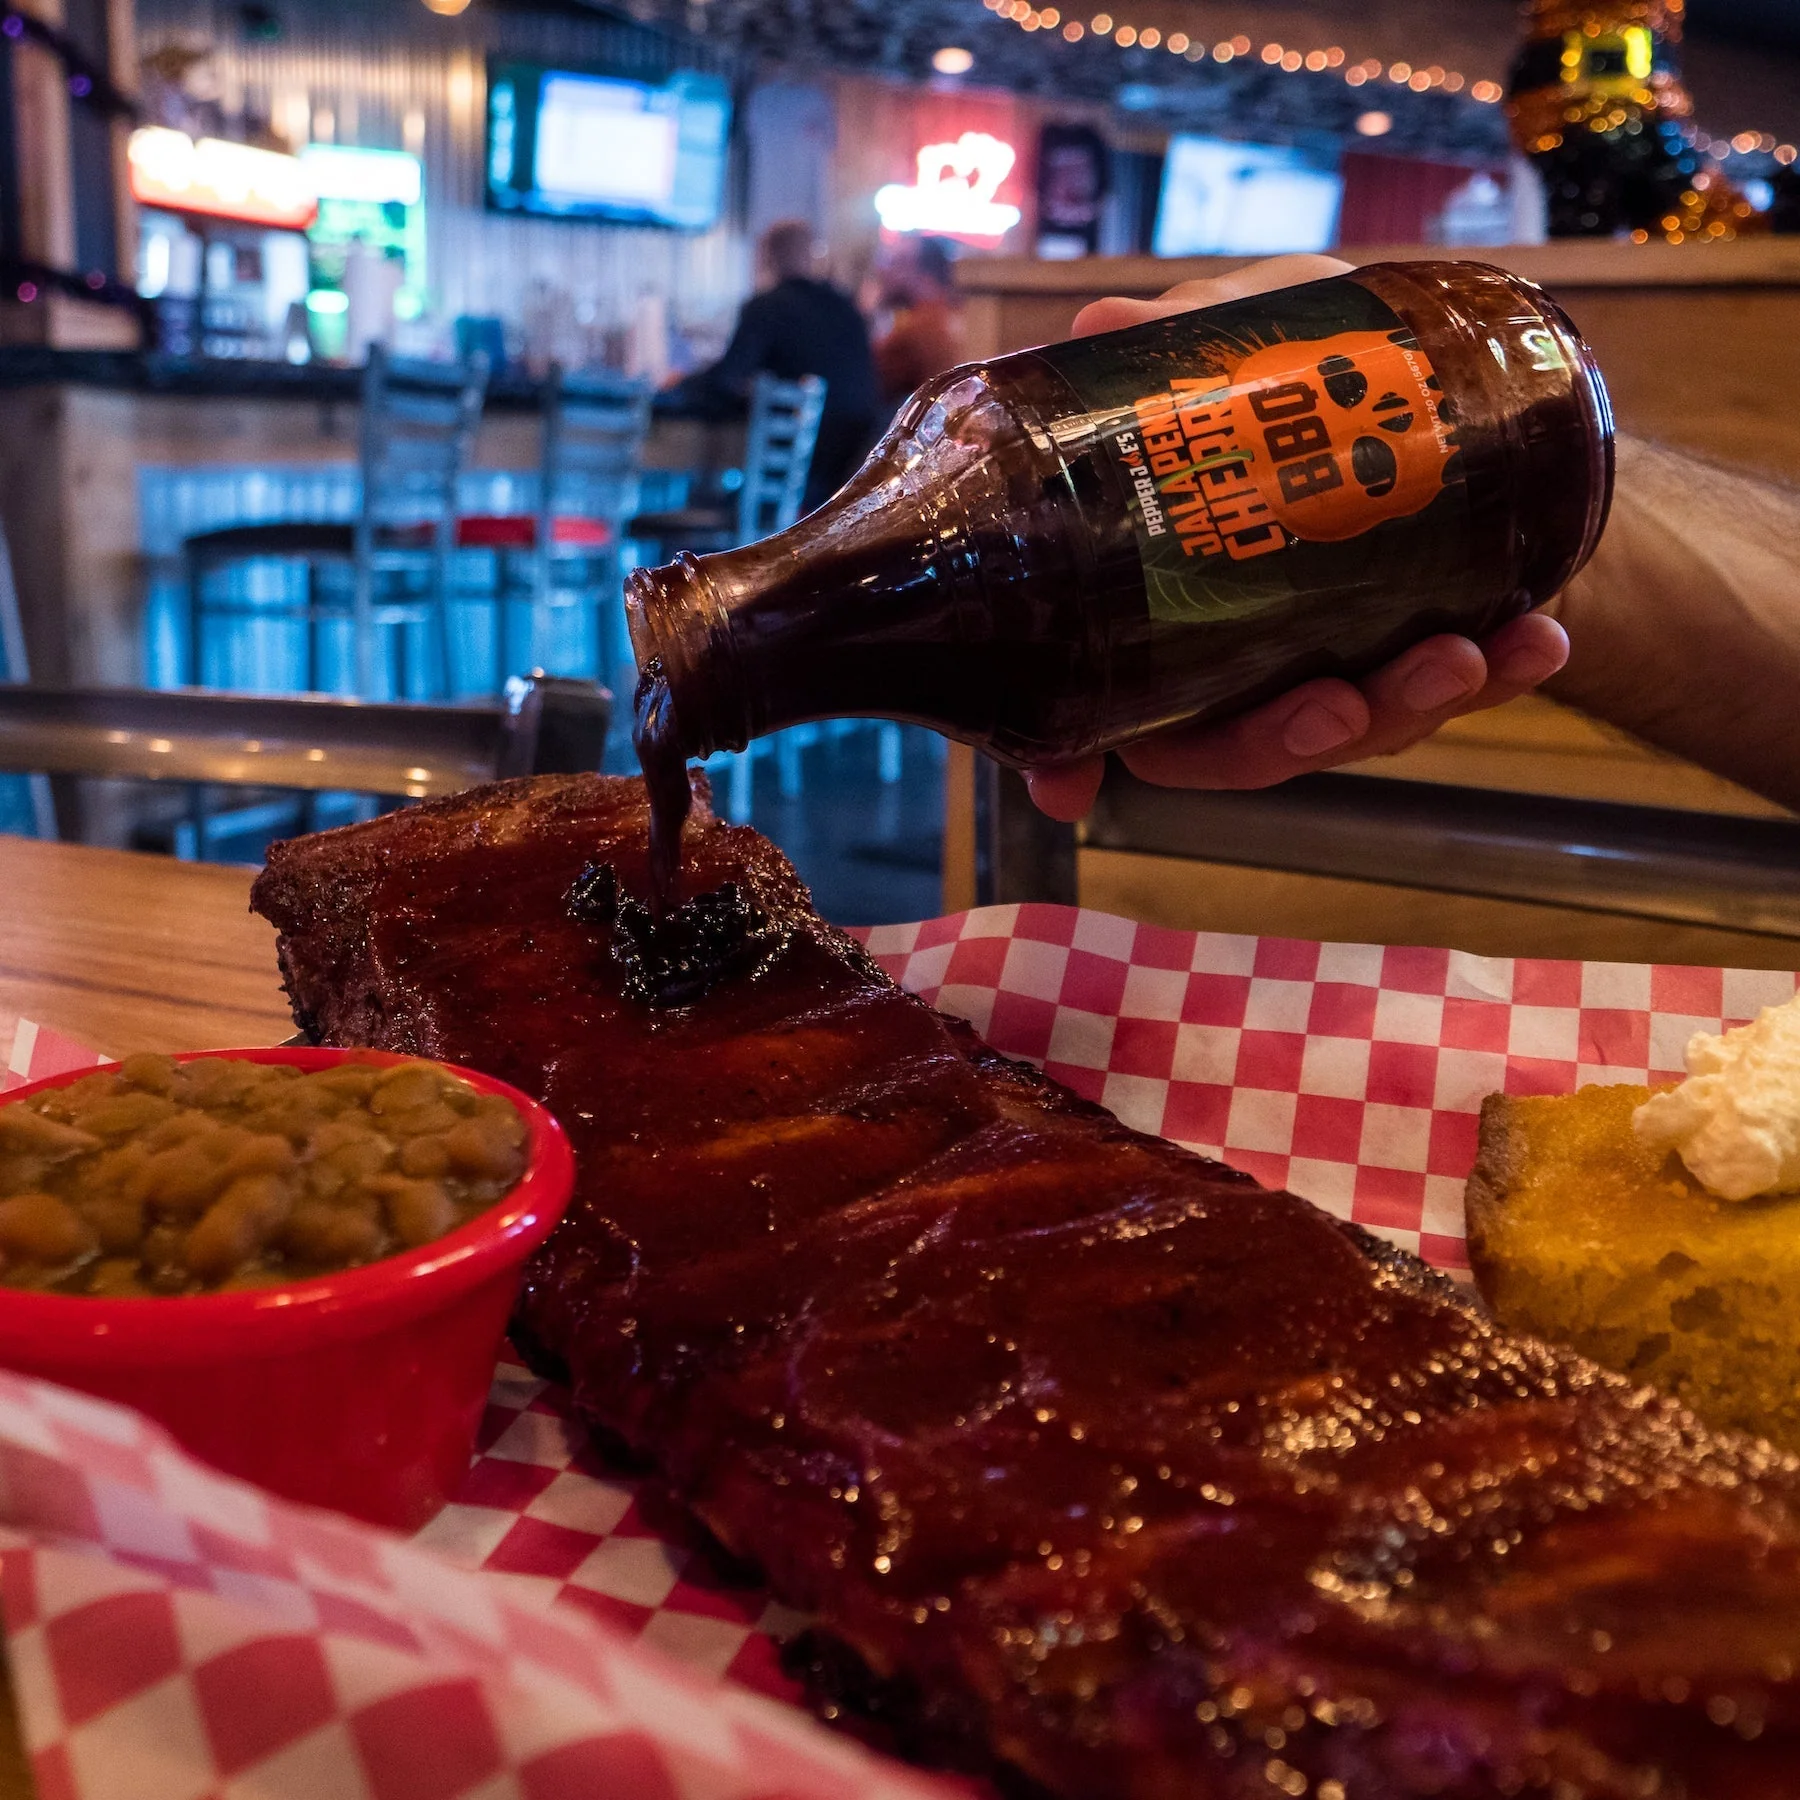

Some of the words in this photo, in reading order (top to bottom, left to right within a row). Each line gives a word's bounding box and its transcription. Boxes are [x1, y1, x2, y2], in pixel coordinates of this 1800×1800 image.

[1401, 350, 1425, 381] (567G)
[1418, 381, 1431, 397] OZ
[1425, 399, 1437, 413] 20
[1430, 415, 1442, 434] WT
[1247, 381, 1345, 505] BBQ
[1436, 434, 1449, 454] NET
[1170, 374, 1287, 561] CHERRY
[1133, 475, 1167, 537] PEPPER
